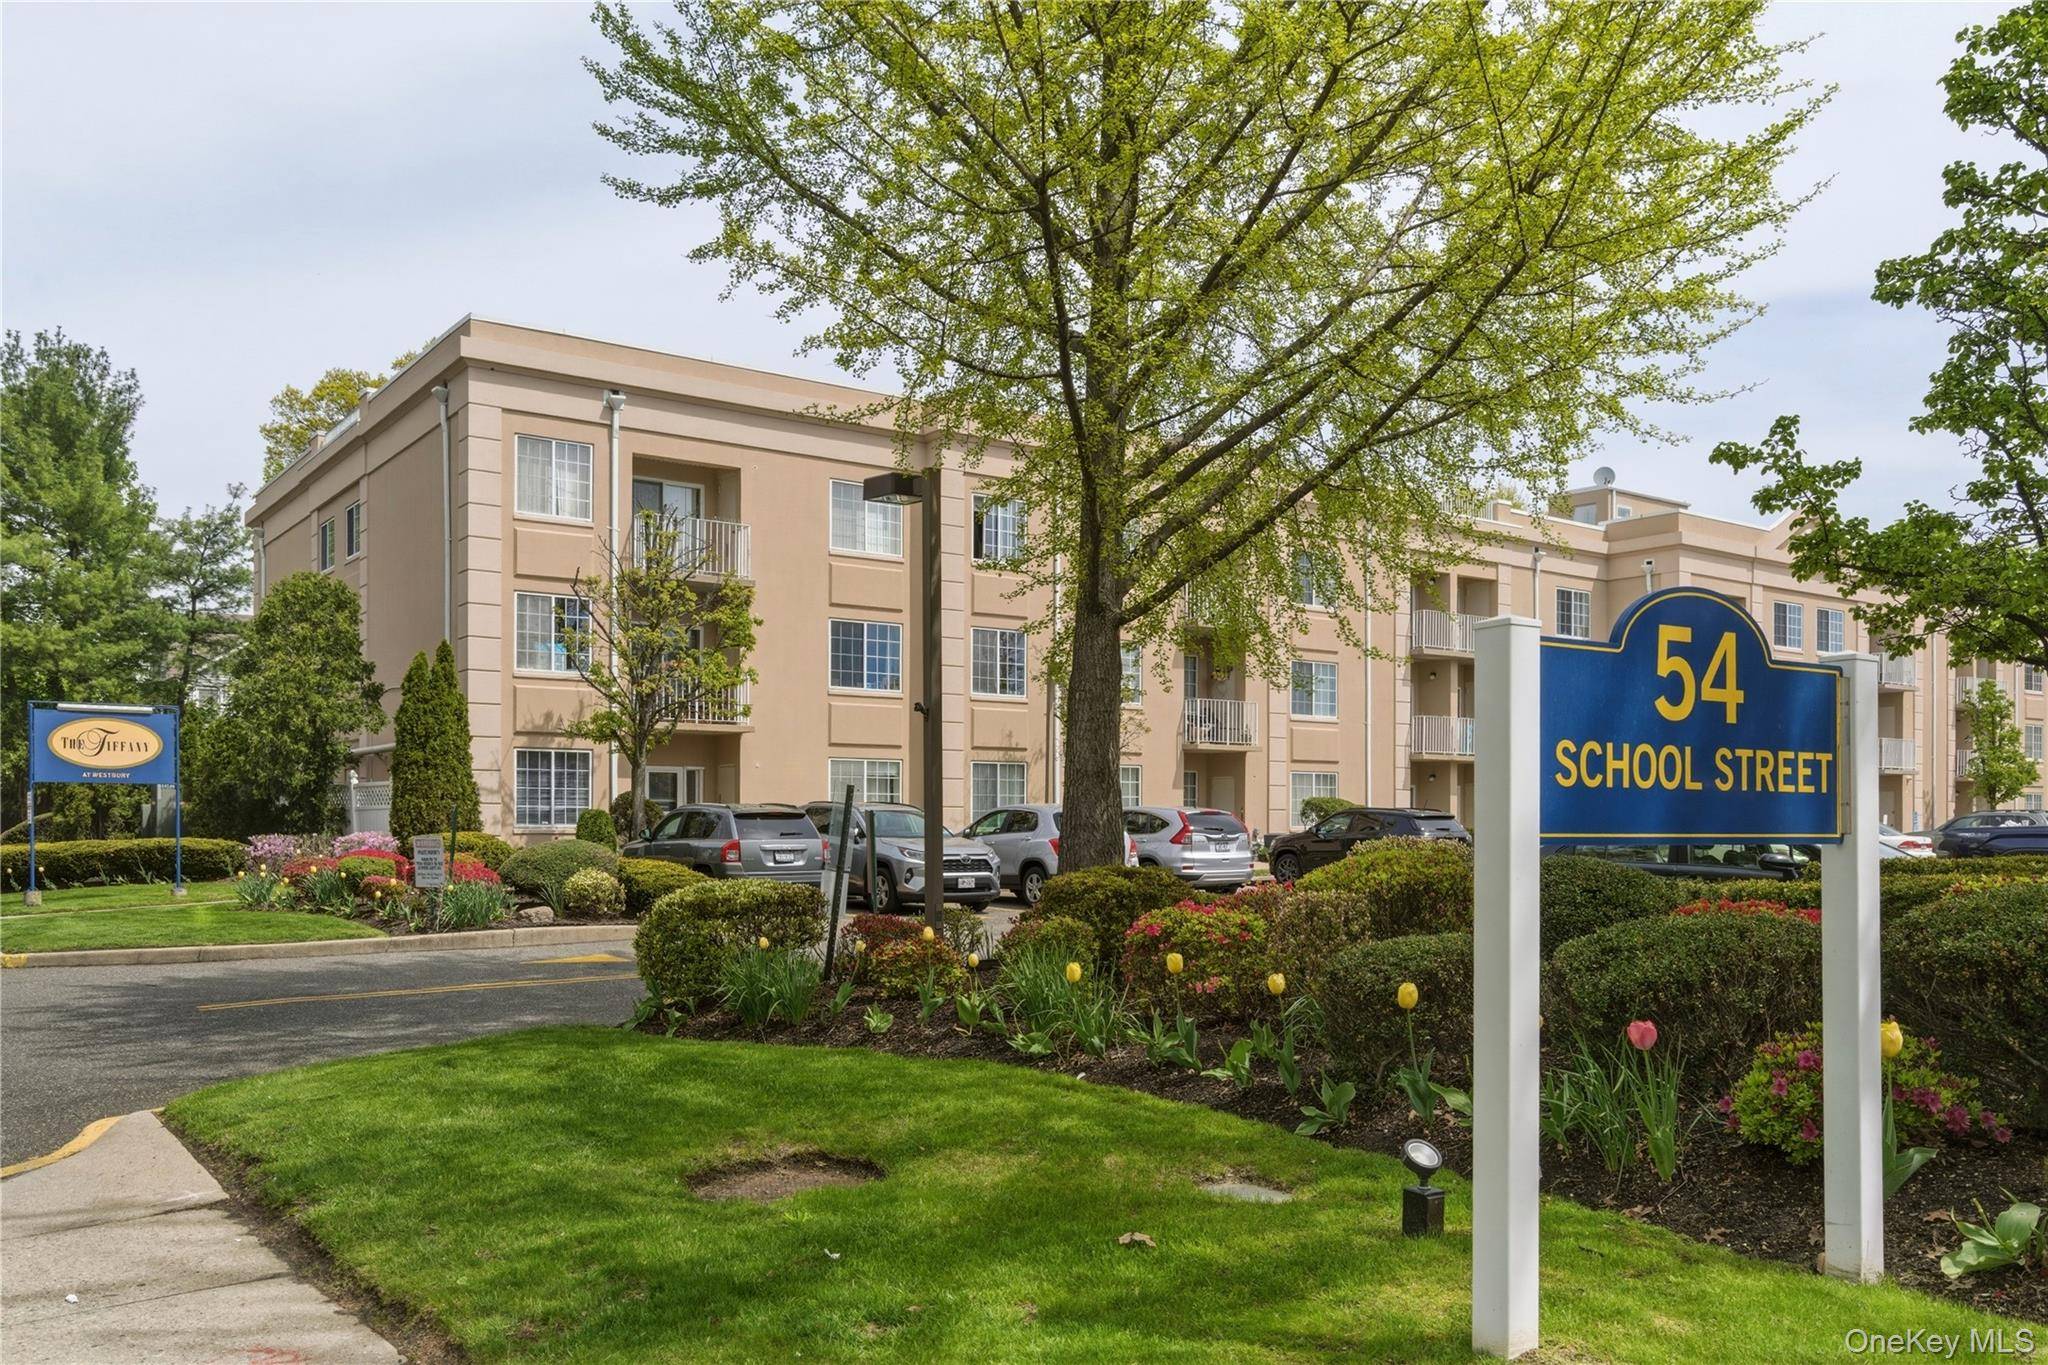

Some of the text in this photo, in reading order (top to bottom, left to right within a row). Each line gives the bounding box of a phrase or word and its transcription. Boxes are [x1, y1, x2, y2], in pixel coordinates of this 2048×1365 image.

[1654, 623, 1745, 724] 54
[61, 727, 149, 757] THE TIFFANY
[1555, 738, 1833, 794] SCHOOL STREET
